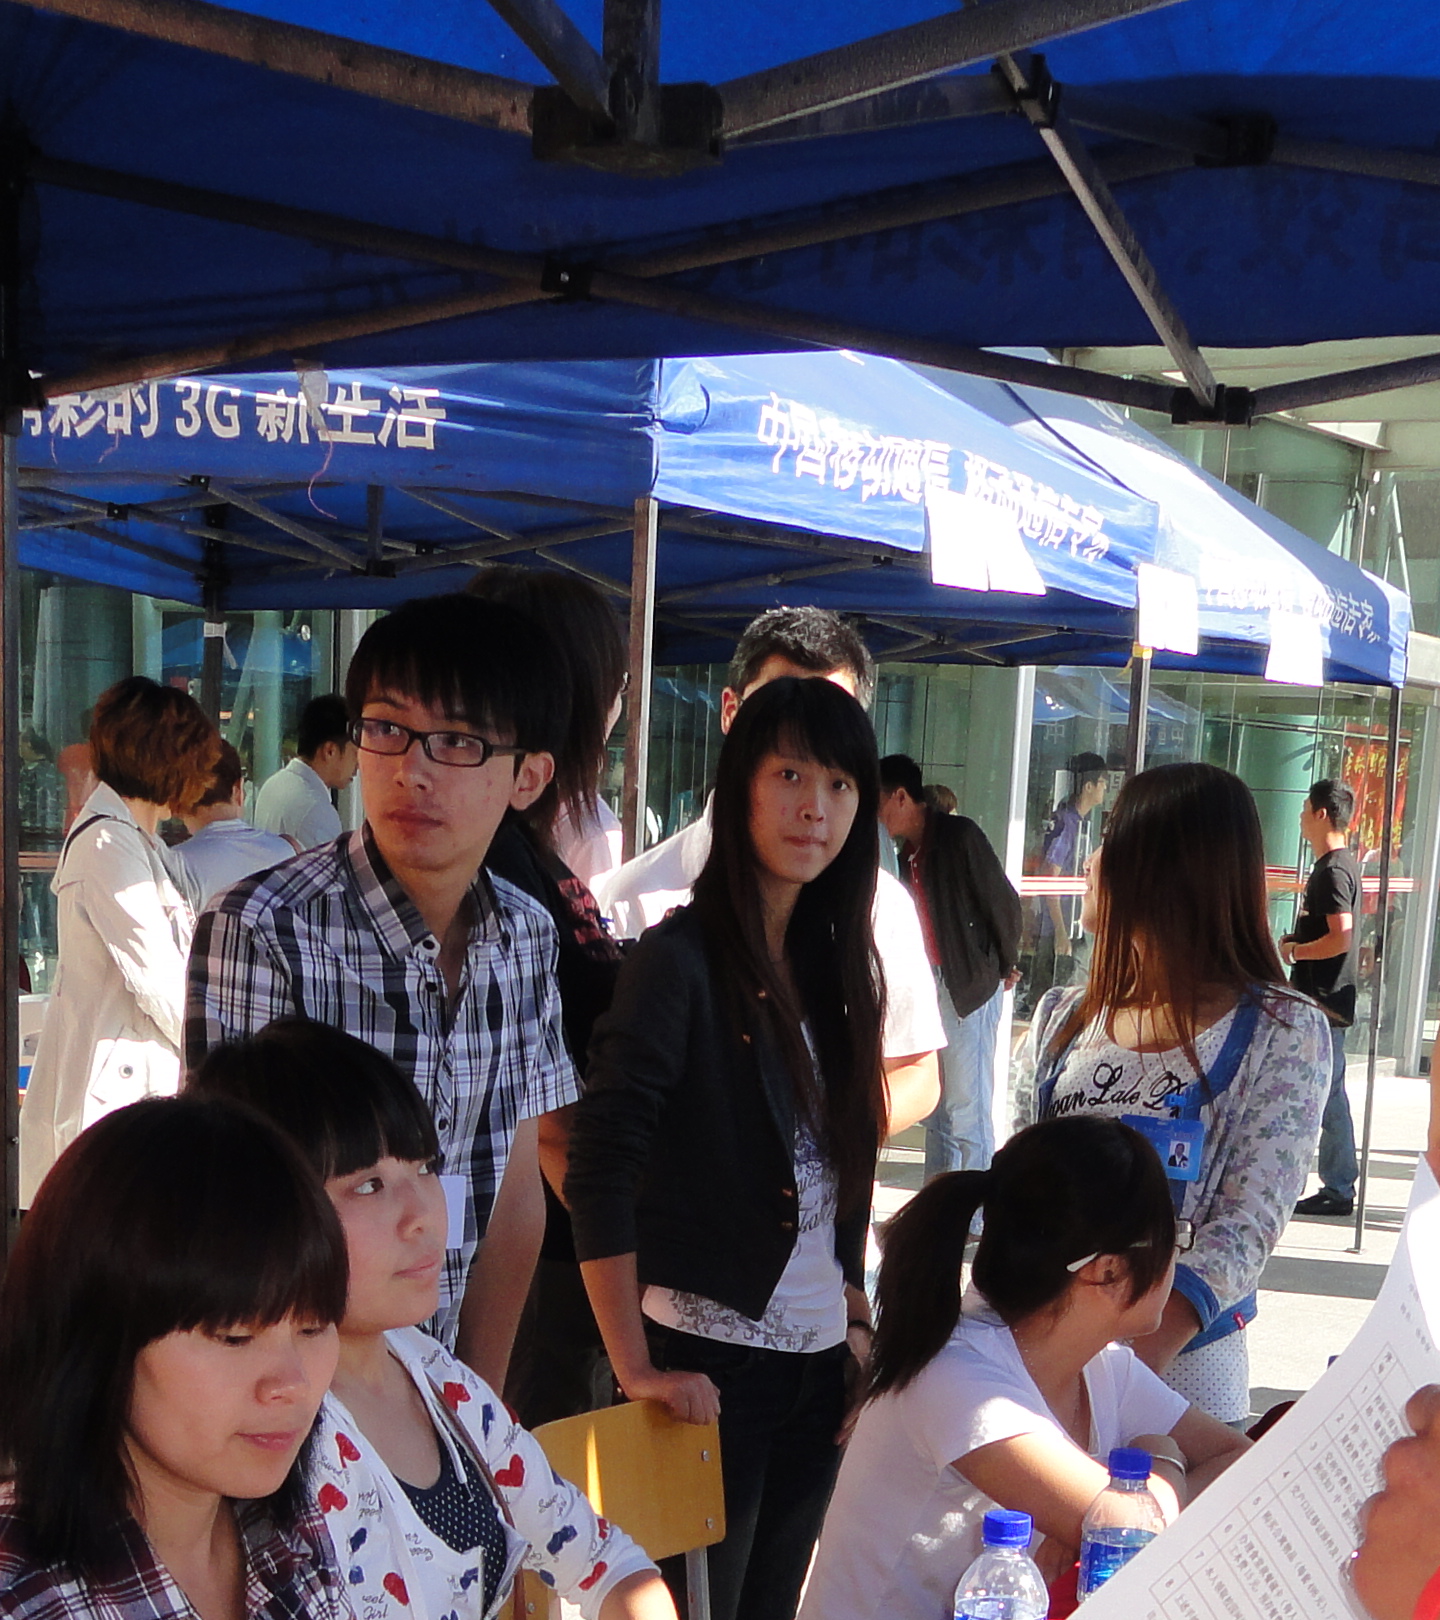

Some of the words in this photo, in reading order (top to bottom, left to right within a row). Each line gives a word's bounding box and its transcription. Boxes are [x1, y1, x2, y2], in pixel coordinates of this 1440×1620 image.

[175, 380, 241, 438] 3G
[255, 381, 447, 450] 新生活
